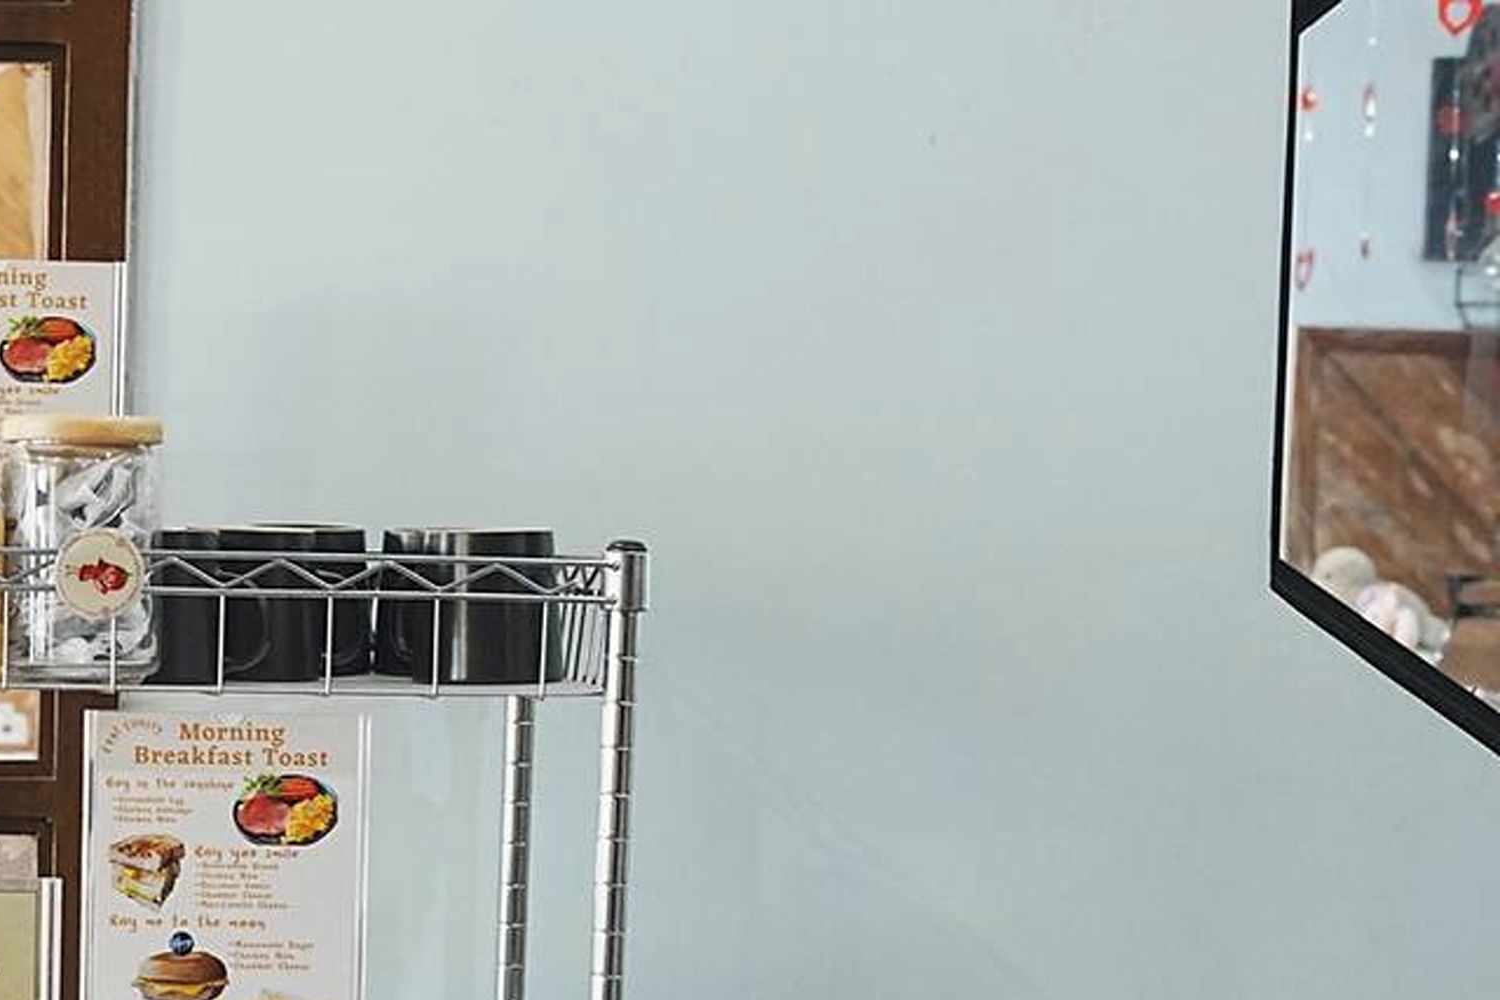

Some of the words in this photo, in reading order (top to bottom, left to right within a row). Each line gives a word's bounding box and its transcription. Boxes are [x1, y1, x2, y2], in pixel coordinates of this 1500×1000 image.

[27, 290, 88, 310] Toast
[179, 721, 286, 746] Morning
[134, 745, 252, 767] Breakfast
[262, 748, 329, 768] Toast
